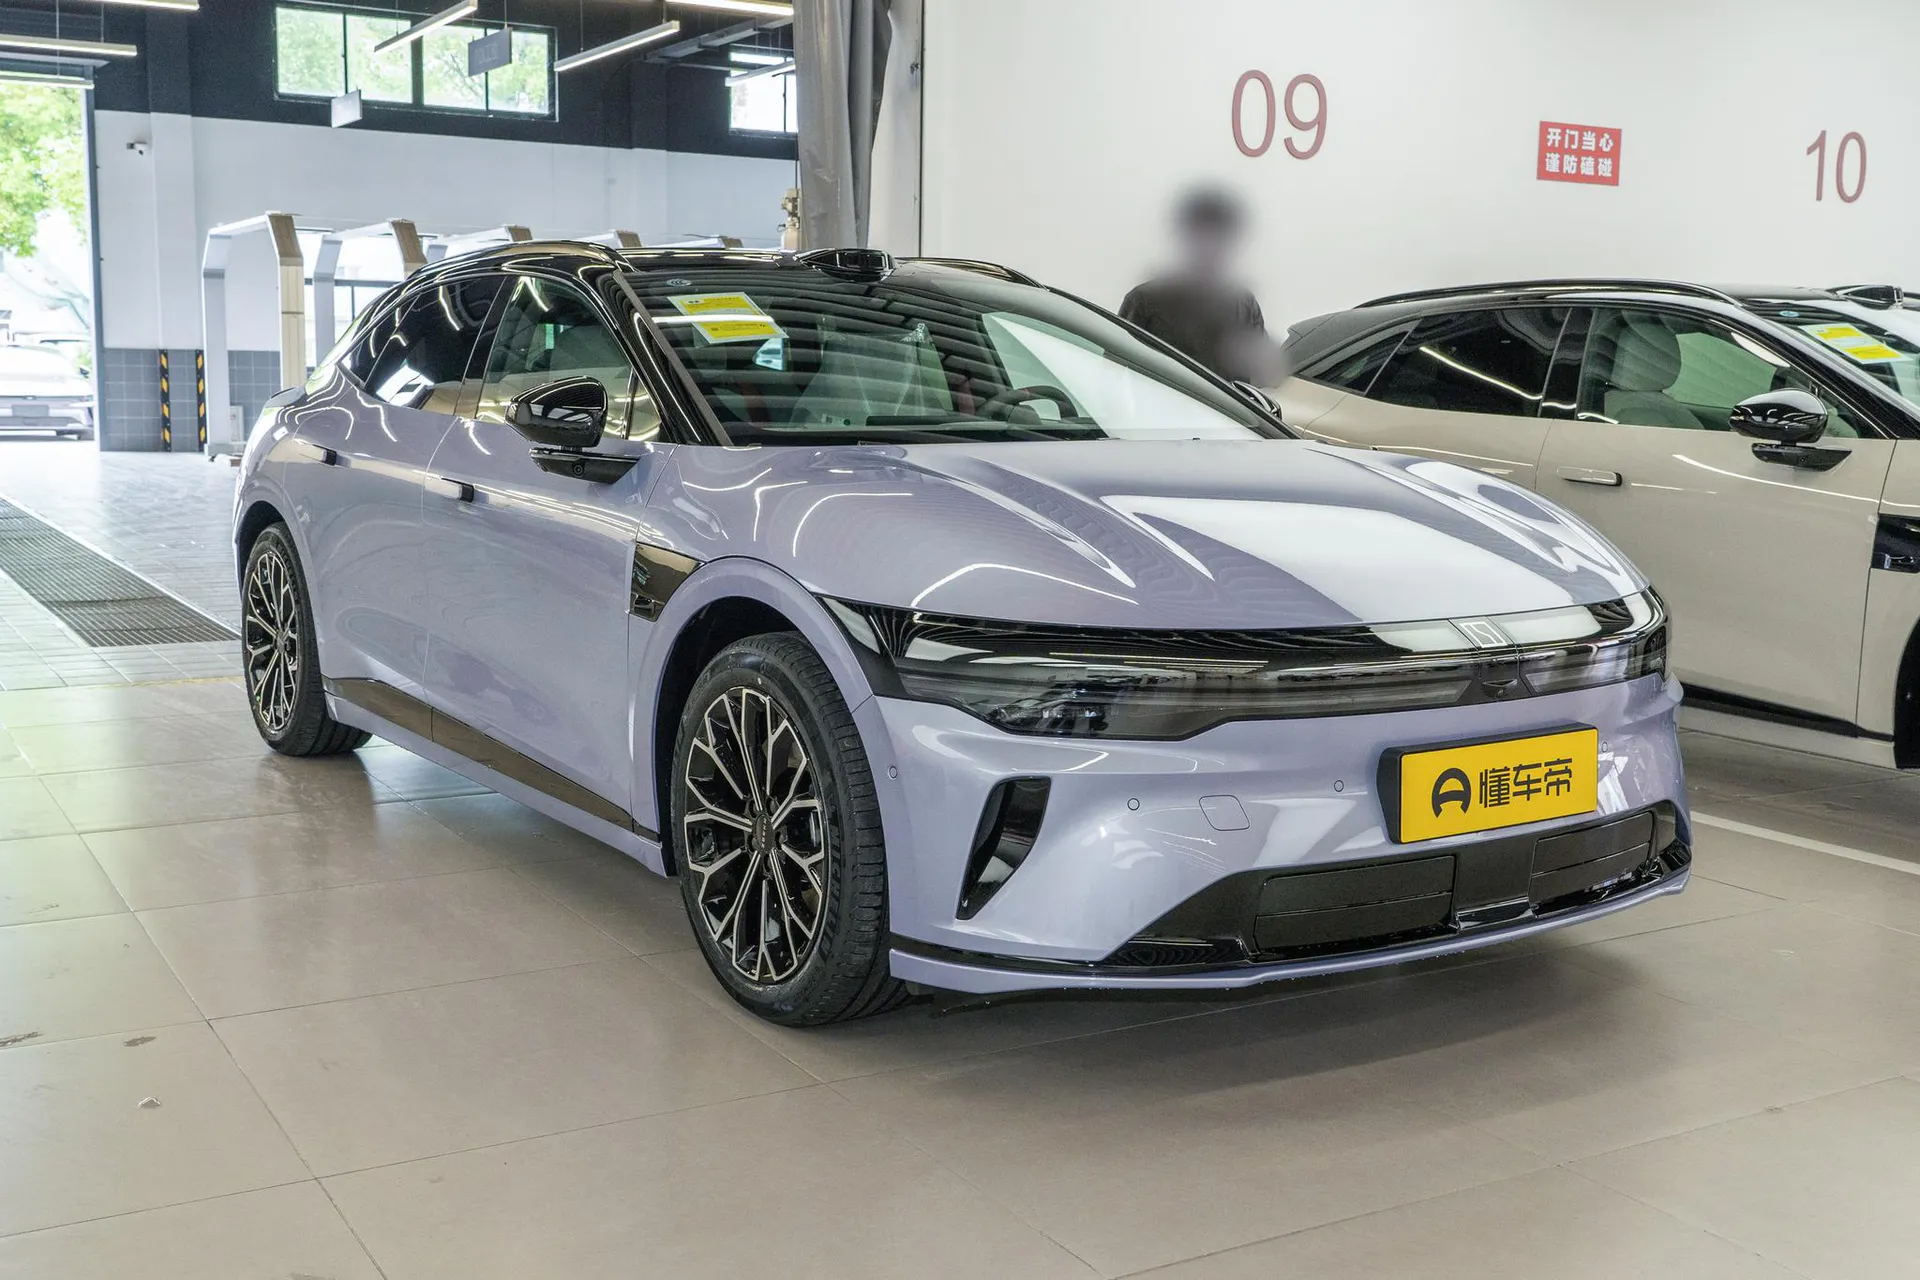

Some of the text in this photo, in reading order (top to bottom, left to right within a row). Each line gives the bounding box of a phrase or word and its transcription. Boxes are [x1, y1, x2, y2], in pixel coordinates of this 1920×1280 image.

[1231, 69, 1327, 160] 09
[1546, 127, 1614, 152] 开门当心
[1545, 152, 1613, 178] 谨防磕碰
[1806, 129, 1867, 203] 10
[1479, 758, 1573, 808] 懂车帝
